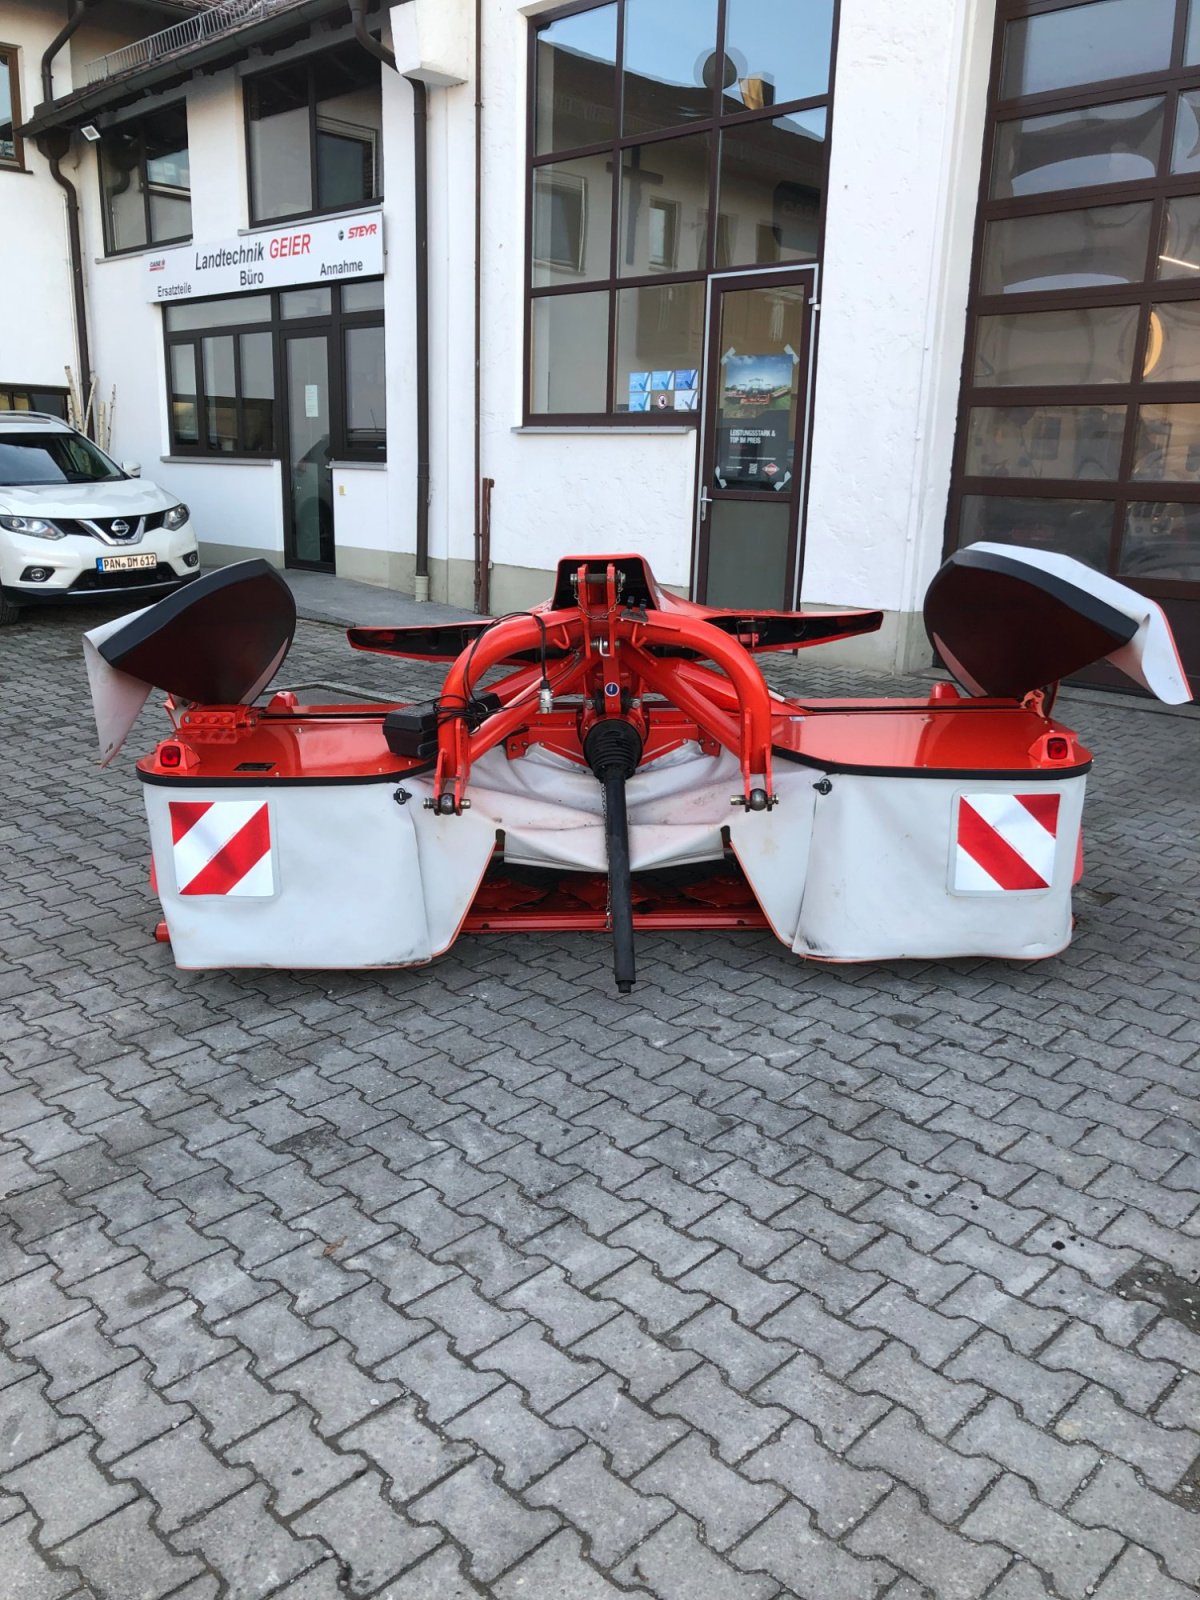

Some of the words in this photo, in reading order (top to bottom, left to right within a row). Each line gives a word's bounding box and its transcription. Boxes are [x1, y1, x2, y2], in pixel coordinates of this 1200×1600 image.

[347, 223, 377, 240] STEYR
[195, 241, 265, 271] Landtechnik
[269, 233, 311, 259] GEIER
[319, 259, 363, 277] Annahme
[239, 269, 264, 286] Büro
[157, 282, 192, 298] Ersatzteile
[746, 436, 761, 444] PREIS
[103, 558, 121, 570] PAN
[127, 557, 138, 568] DM
[140, 555, 155, 566] 612
